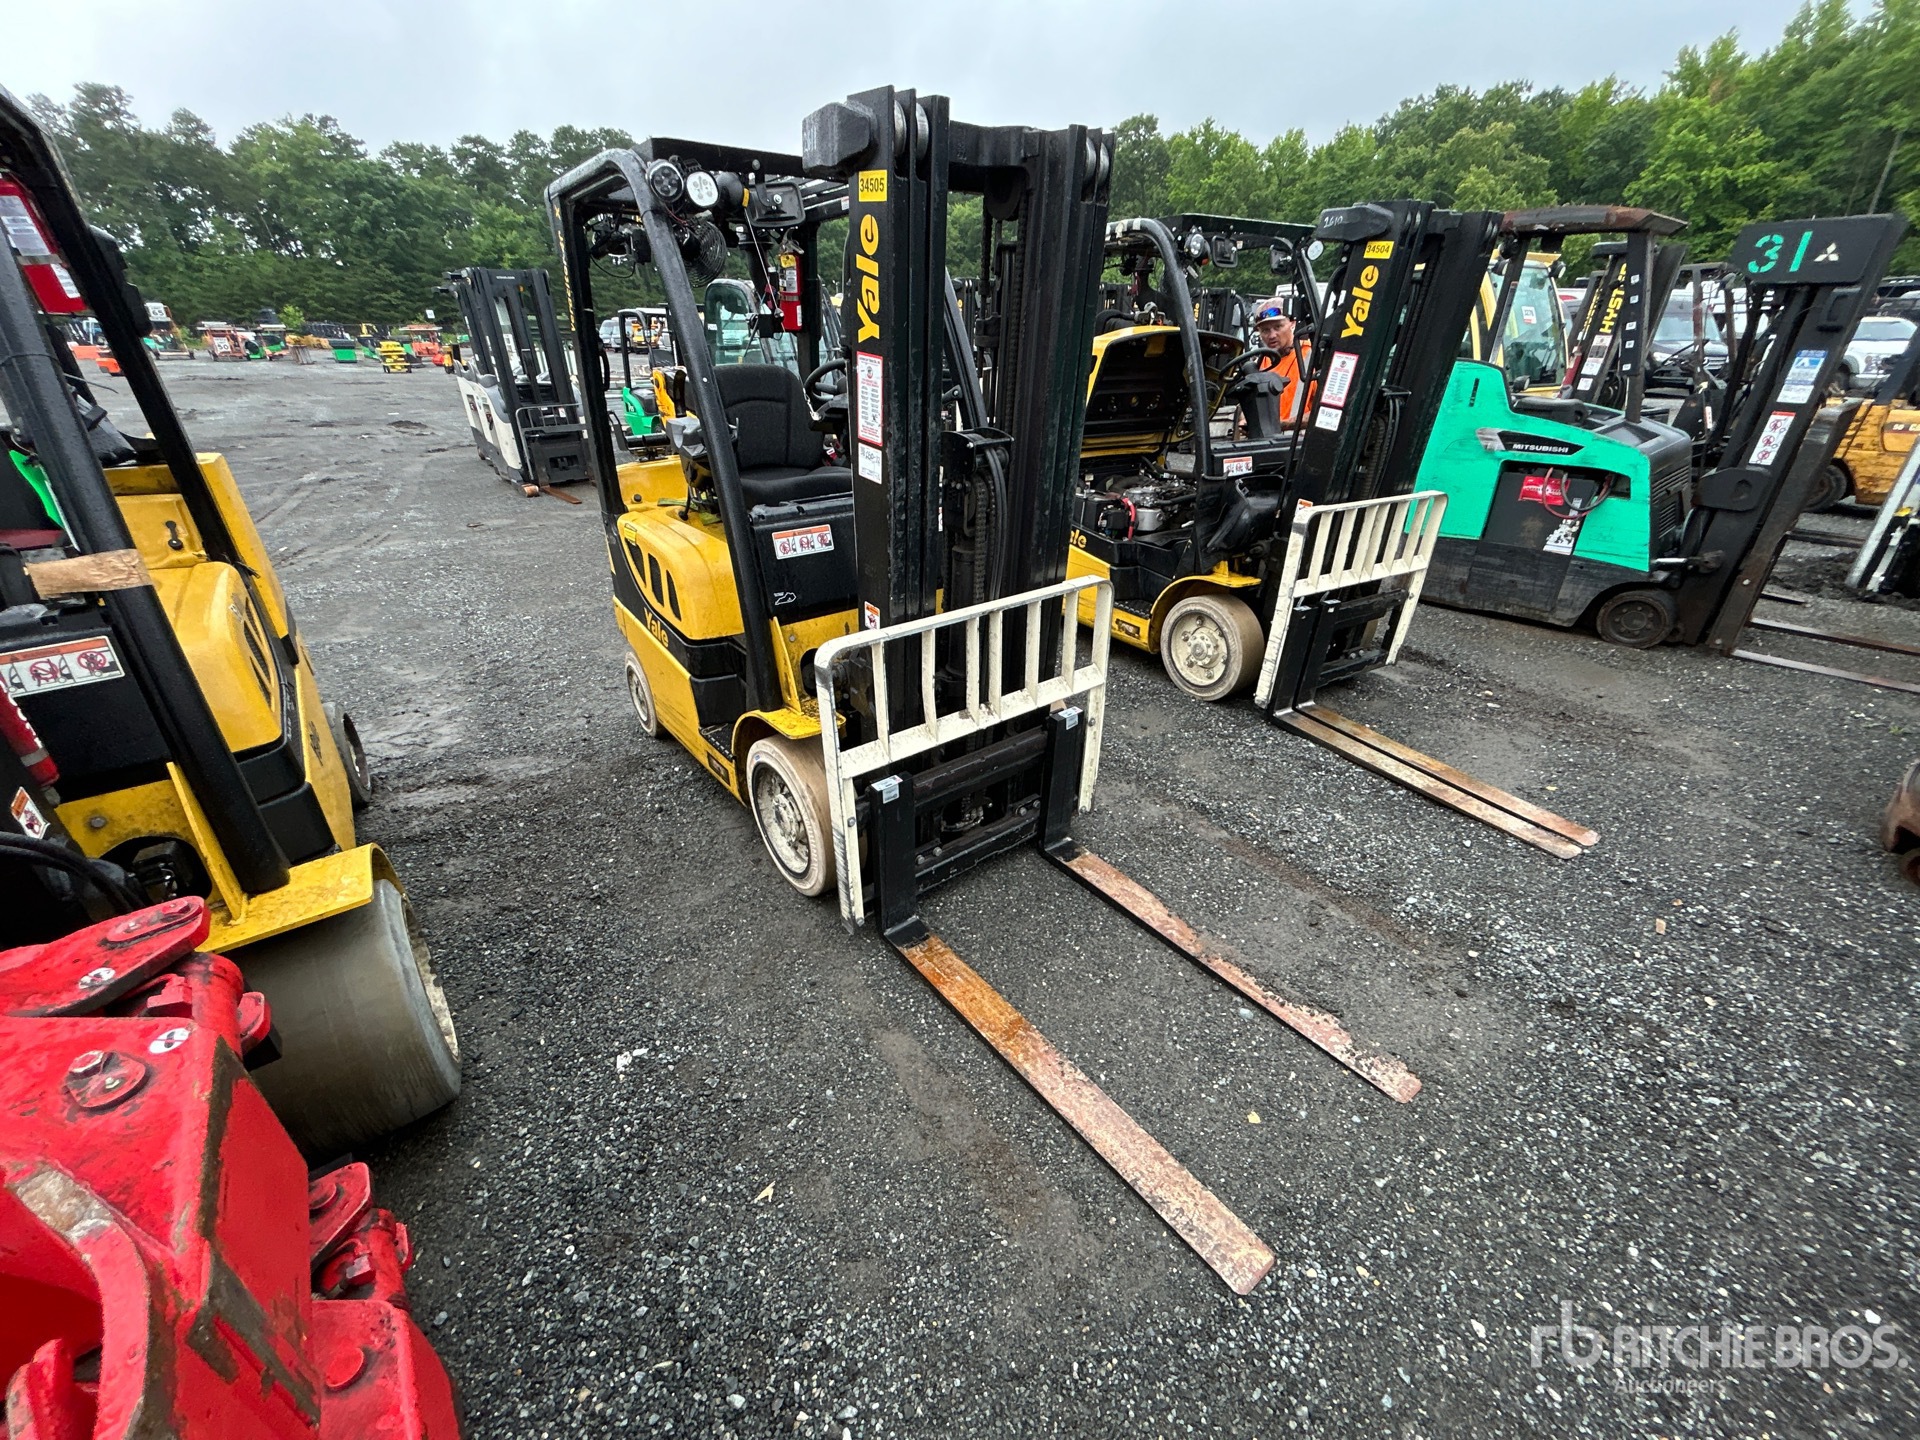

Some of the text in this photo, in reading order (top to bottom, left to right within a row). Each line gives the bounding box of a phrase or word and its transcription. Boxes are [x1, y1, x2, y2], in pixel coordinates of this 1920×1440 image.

[859, 177, 885, 192] 34505
[1366, 244, 1390, 254] 34504
[856, 213, 880, 344] Yale
[1341, 264, 1380, 339] Yale
[1512, 443, 1569, 454] MITSUBISHI
[643, 606, 669, 648] Yale
